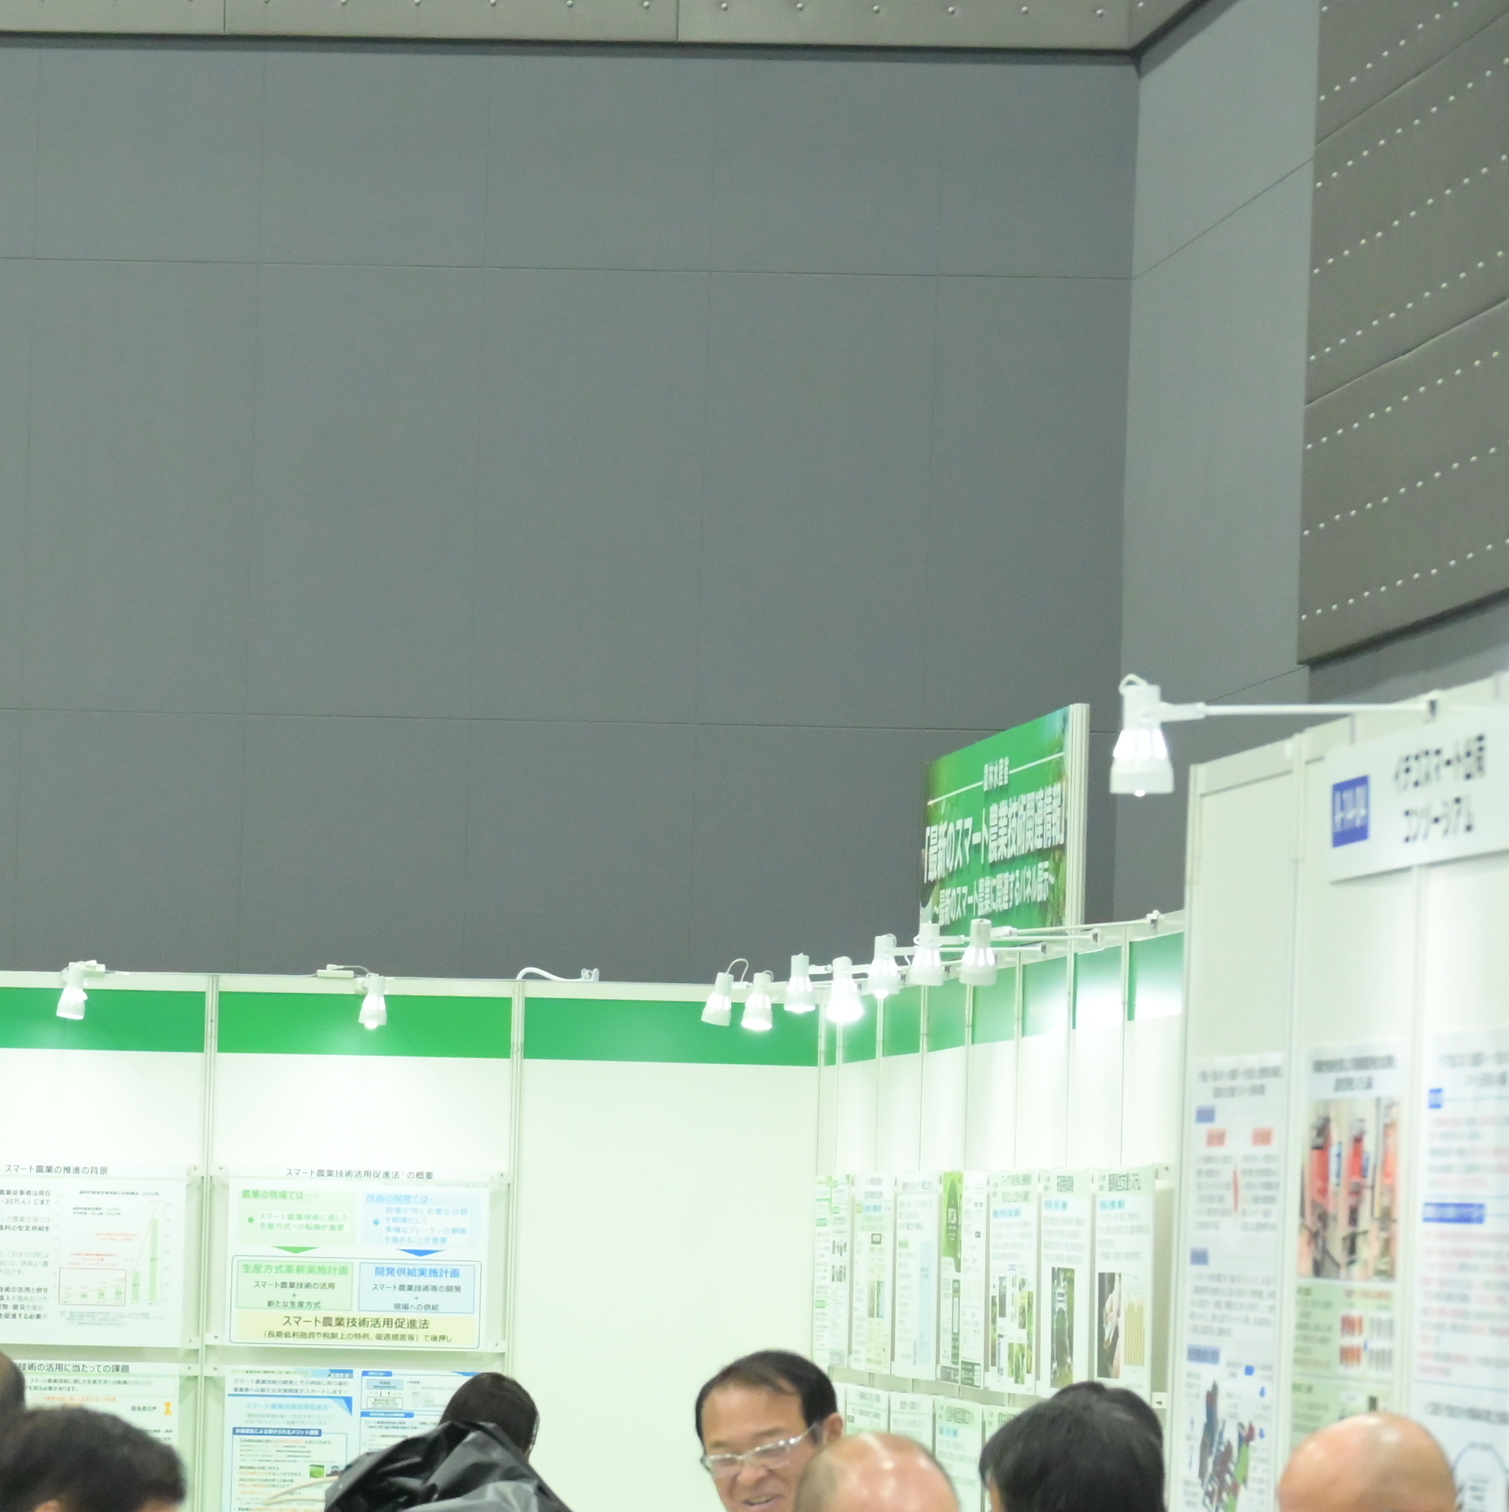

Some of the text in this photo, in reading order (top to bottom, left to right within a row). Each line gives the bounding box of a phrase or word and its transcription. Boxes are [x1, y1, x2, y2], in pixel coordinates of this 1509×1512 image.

[5, 1164, 109, 1175] スマート農業の推進の背景
[242, 1263, 349, 1276] 生産方式革新実施計画
[374, 1266, 460, 1279] 開発供給実施計画
[254, 1280, 336, 1290] スマート農業技術の活用
[282, 1315, 430, 1330] スマート農業技術活用促進法
